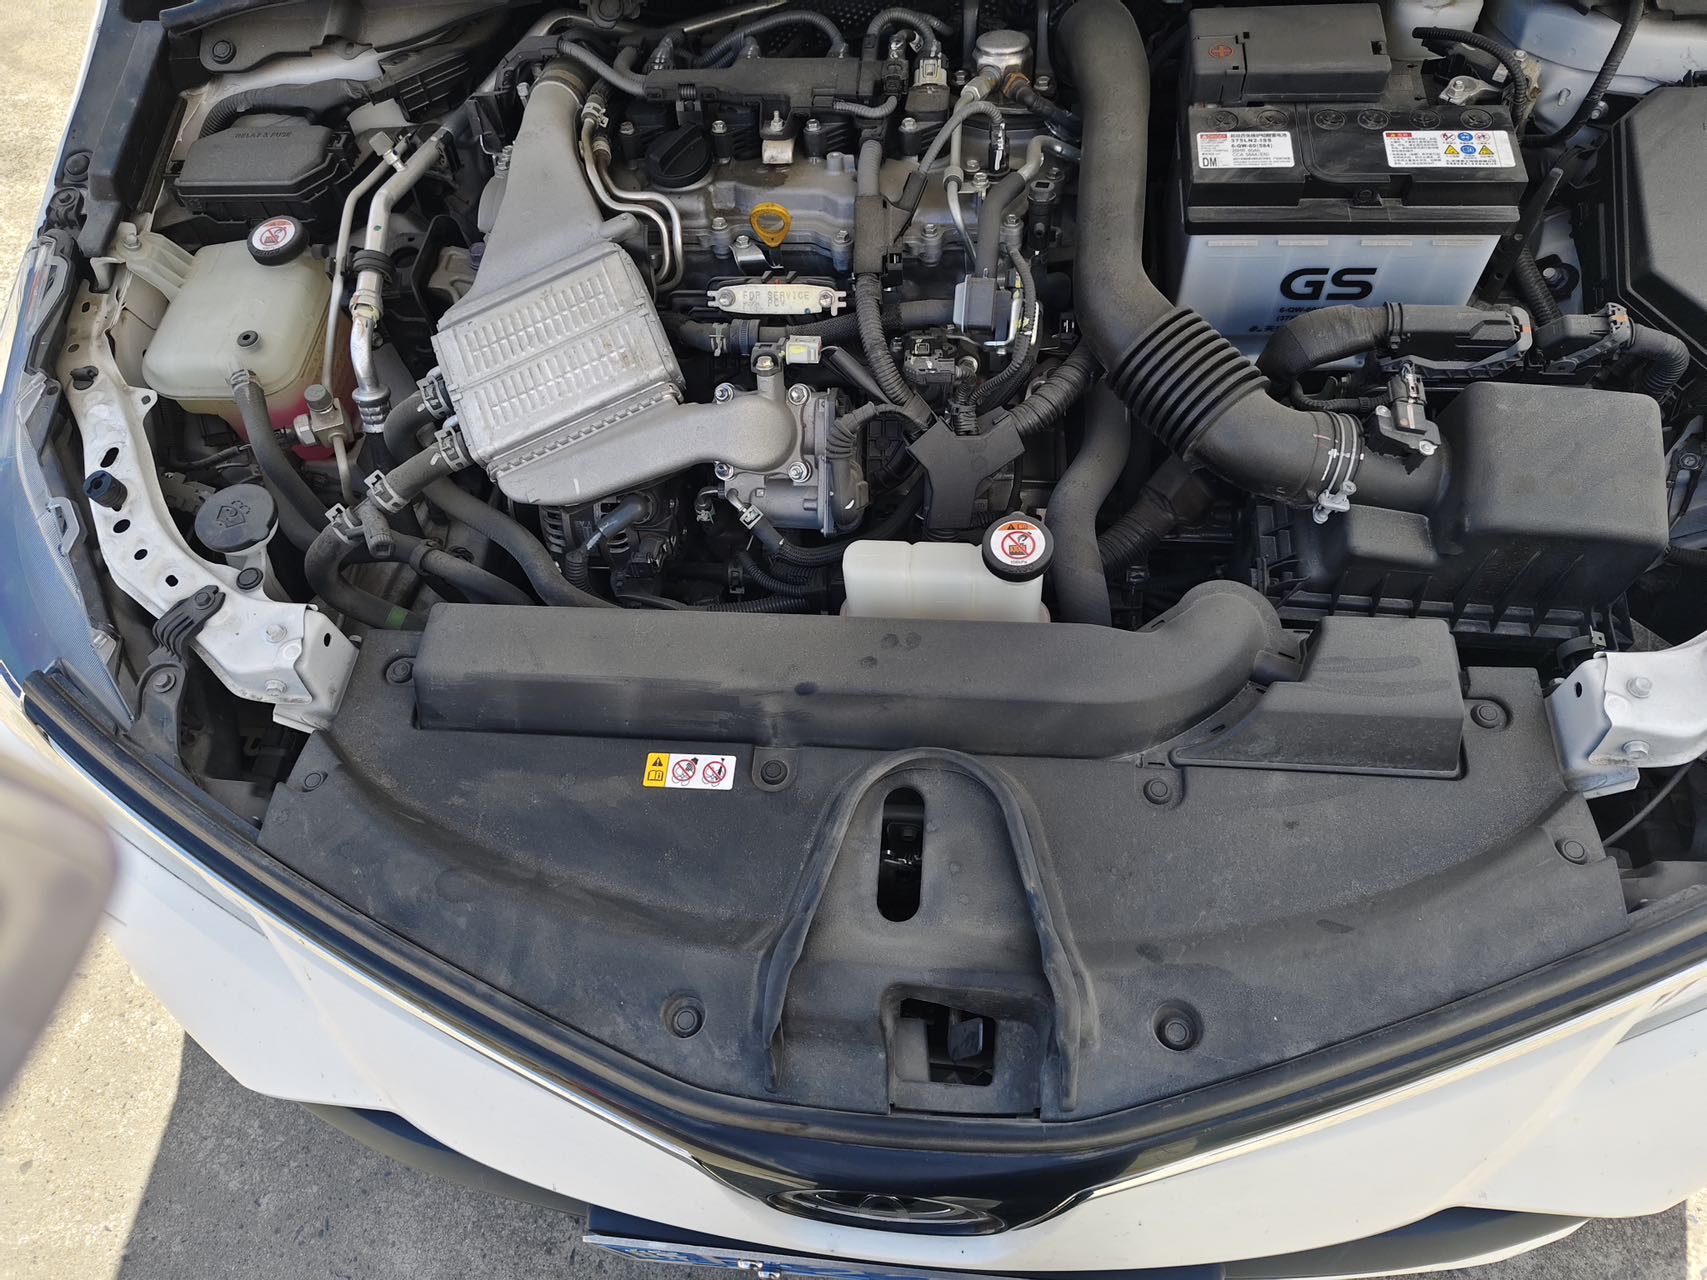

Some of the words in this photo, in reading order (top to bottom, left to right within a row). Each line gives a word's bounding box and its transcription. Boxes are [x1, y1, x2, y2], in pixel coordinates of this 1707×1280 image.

[1202, 157, 1218, 167] DM
[1280, 268, 1377, 300] GS
[767, 291, 810, 300] SERVICE
